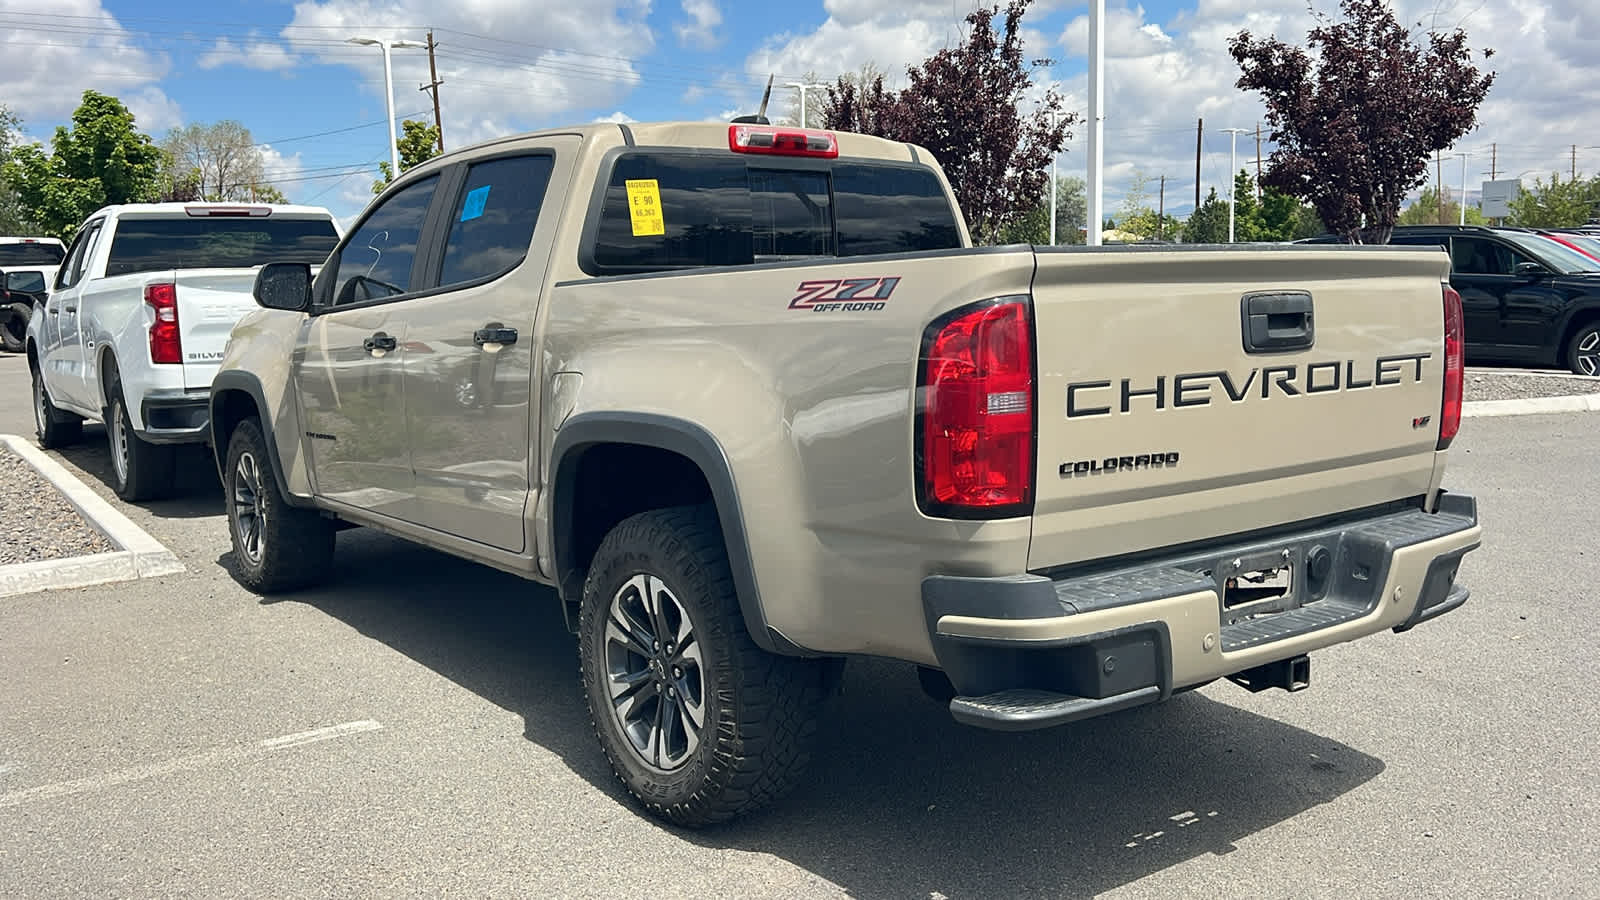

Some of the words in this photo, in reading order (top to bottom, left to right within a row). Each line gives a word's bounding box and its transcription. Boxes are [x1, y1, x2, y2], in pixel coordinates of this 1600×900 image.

[788, 276, 902, 309] Z71
[813, 303, 841, 312] OFF
[842, 302, 885, 312] ROAD
[1067, 353, 1431, 418] CHEVROLET
[1059, 452, 1179, 477] COLORADO
